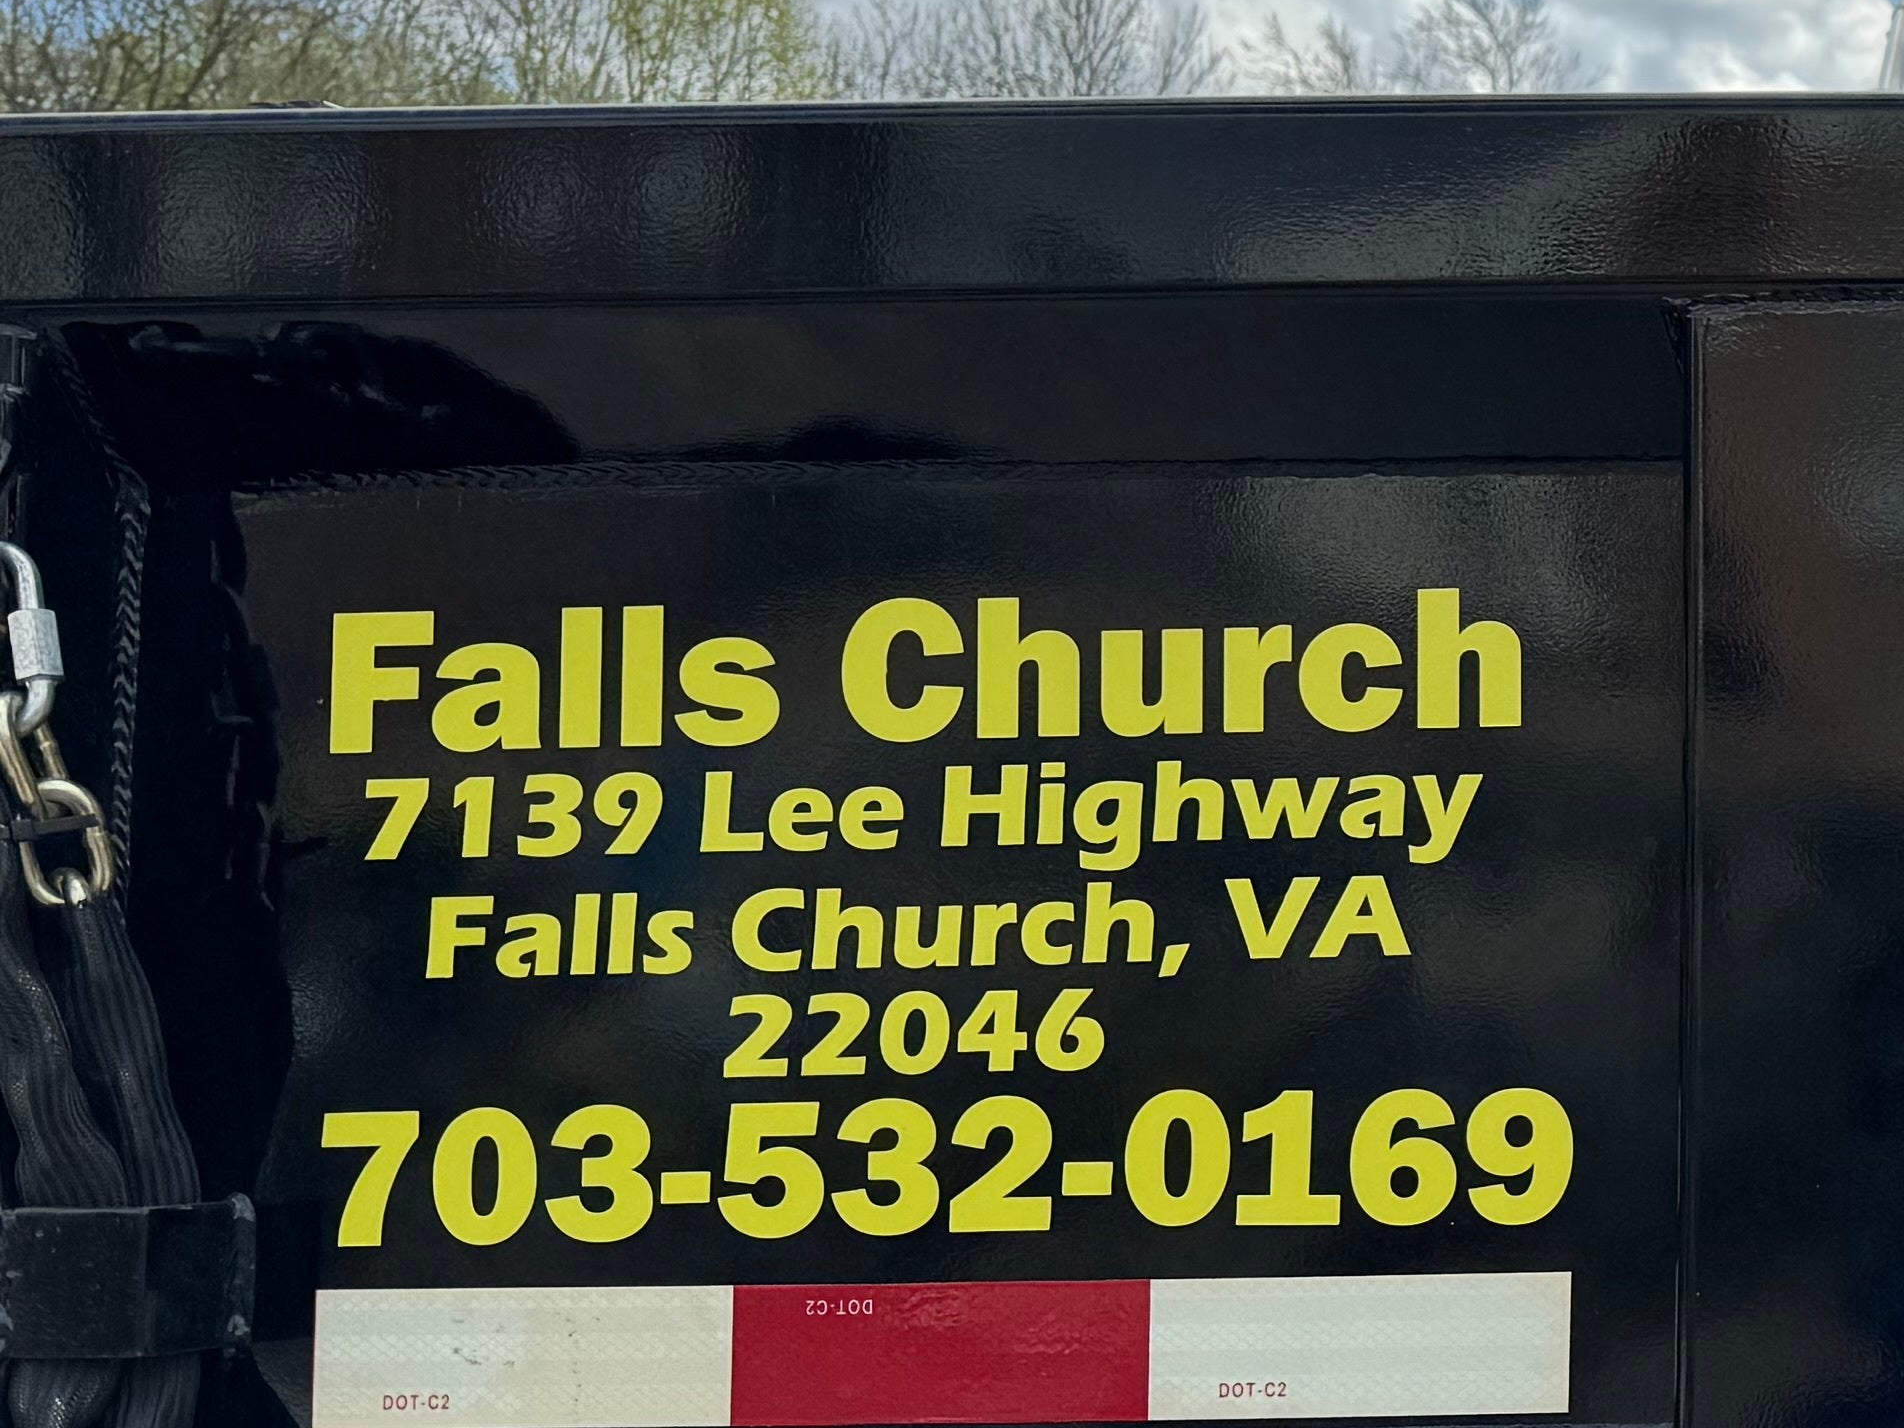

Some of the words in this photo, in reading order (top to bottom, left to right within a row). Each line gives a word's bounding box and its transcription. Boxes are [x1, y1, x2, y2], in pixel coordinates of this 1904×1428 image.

[332, 607, 779, 753] Falls
[844, 590, 1521, 742] Church
[368, 774, 662, 860] 7139
[703, 774, 904, 852] Lee
[944, 763, 1480, 870] Highway
[428, 895, 693, 978] Falls
[734, 884, 1188, 976] Church,
[1228, 878, 1408, 959] VA
[726, 991, 1104, 1078] 22046
[324, 1090, 1573, 1247] 703-532-0169
[806, 1299, 875, 1317] DOT-C2
[383, 1393, 450, 1411] DOT-C2
[1218, 1380, 1288, 1399] DOT-C2
